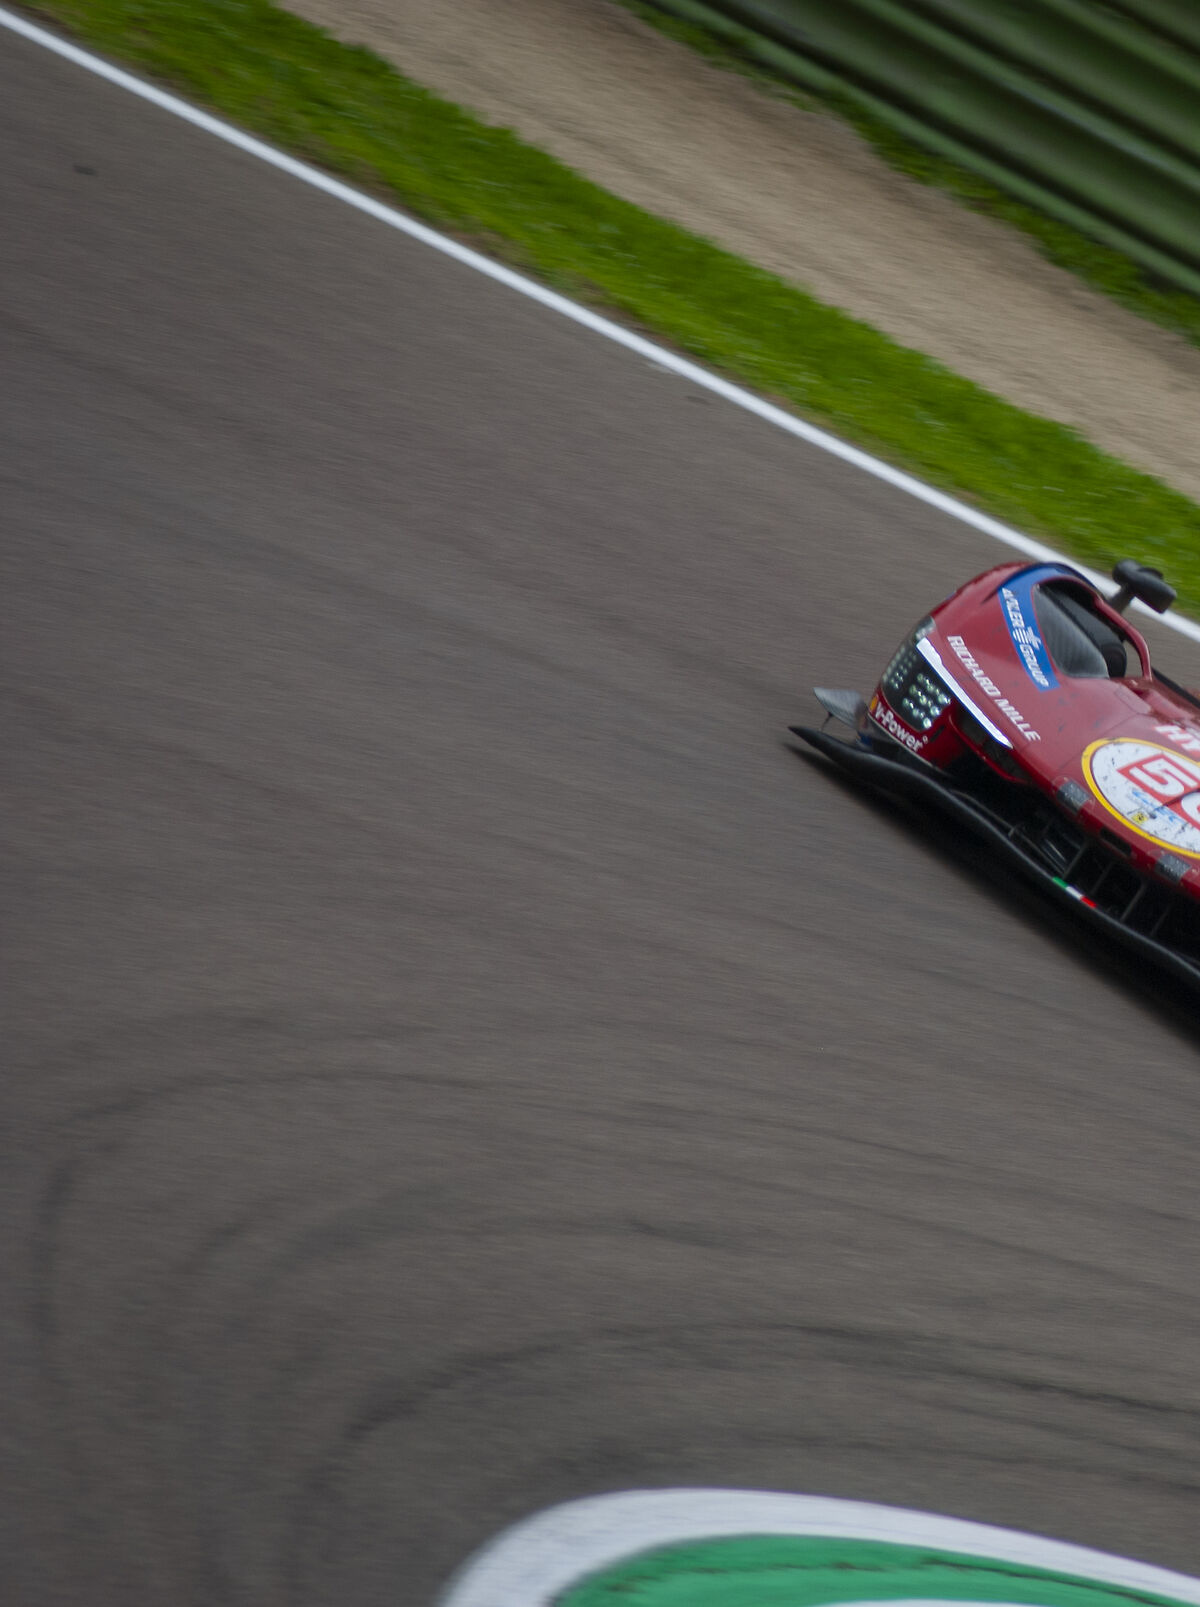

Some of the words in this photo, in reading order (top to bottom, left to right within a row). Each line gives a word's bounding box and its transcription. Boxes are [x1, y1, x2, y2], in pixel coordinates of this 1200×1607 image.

[947, 635, 1001, 701] RICHARD
[995, 698, 1041, 742] MILLE
[1019, 644, 1050, 688] GROUP
[873, 702, 923, 752] V-Power
